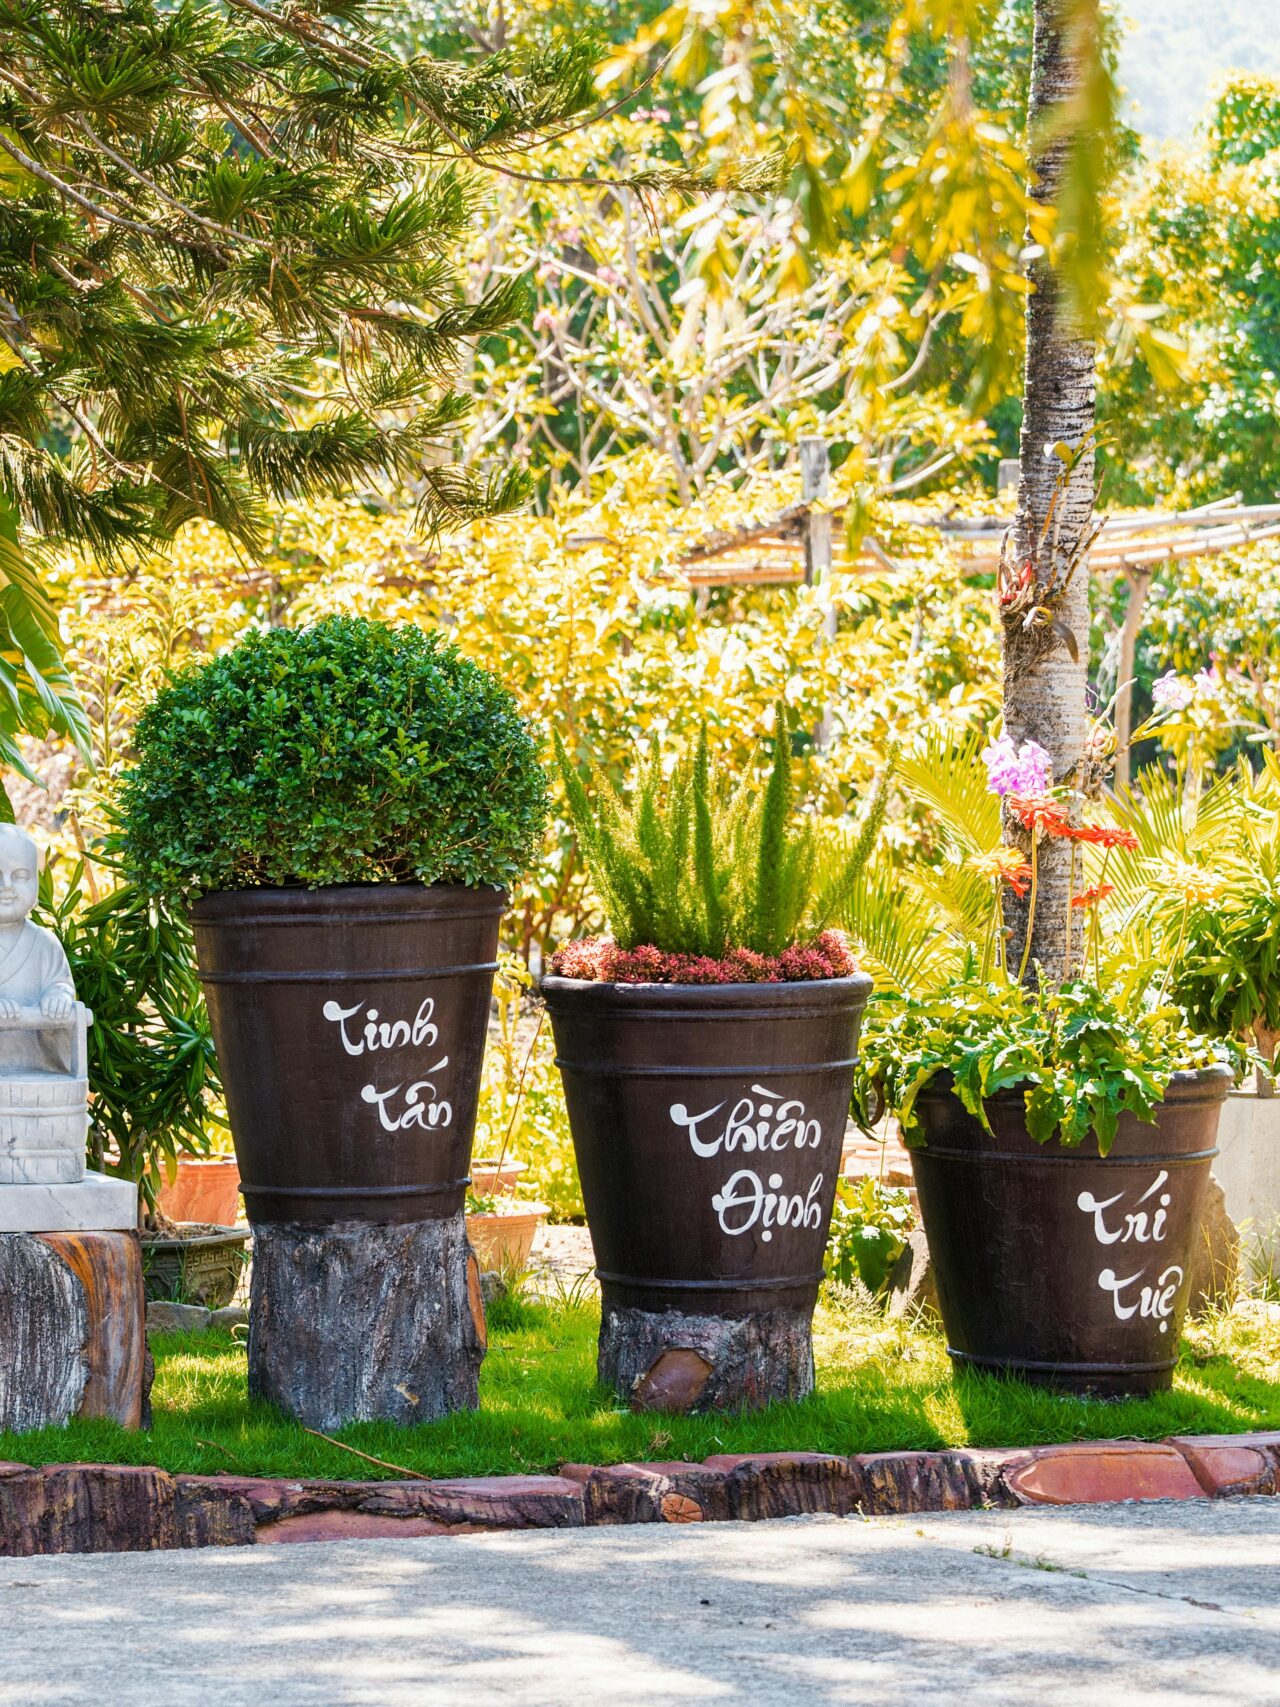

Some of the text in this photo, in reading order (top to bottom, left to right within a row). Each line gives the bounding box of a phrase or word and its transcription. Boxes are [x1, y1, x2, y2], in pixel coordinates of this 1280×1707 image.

[322, 997, 439, 1056] Tinh
[360, 1055, 453, 1132] Tấn
[669, 1083, 822, 1158] Thiền
[711, 1169, 824, 1243] Định
[1076, 1170, 1171, 1245] Trí
[1097, 1265, 1184, 1333] Tuệ
